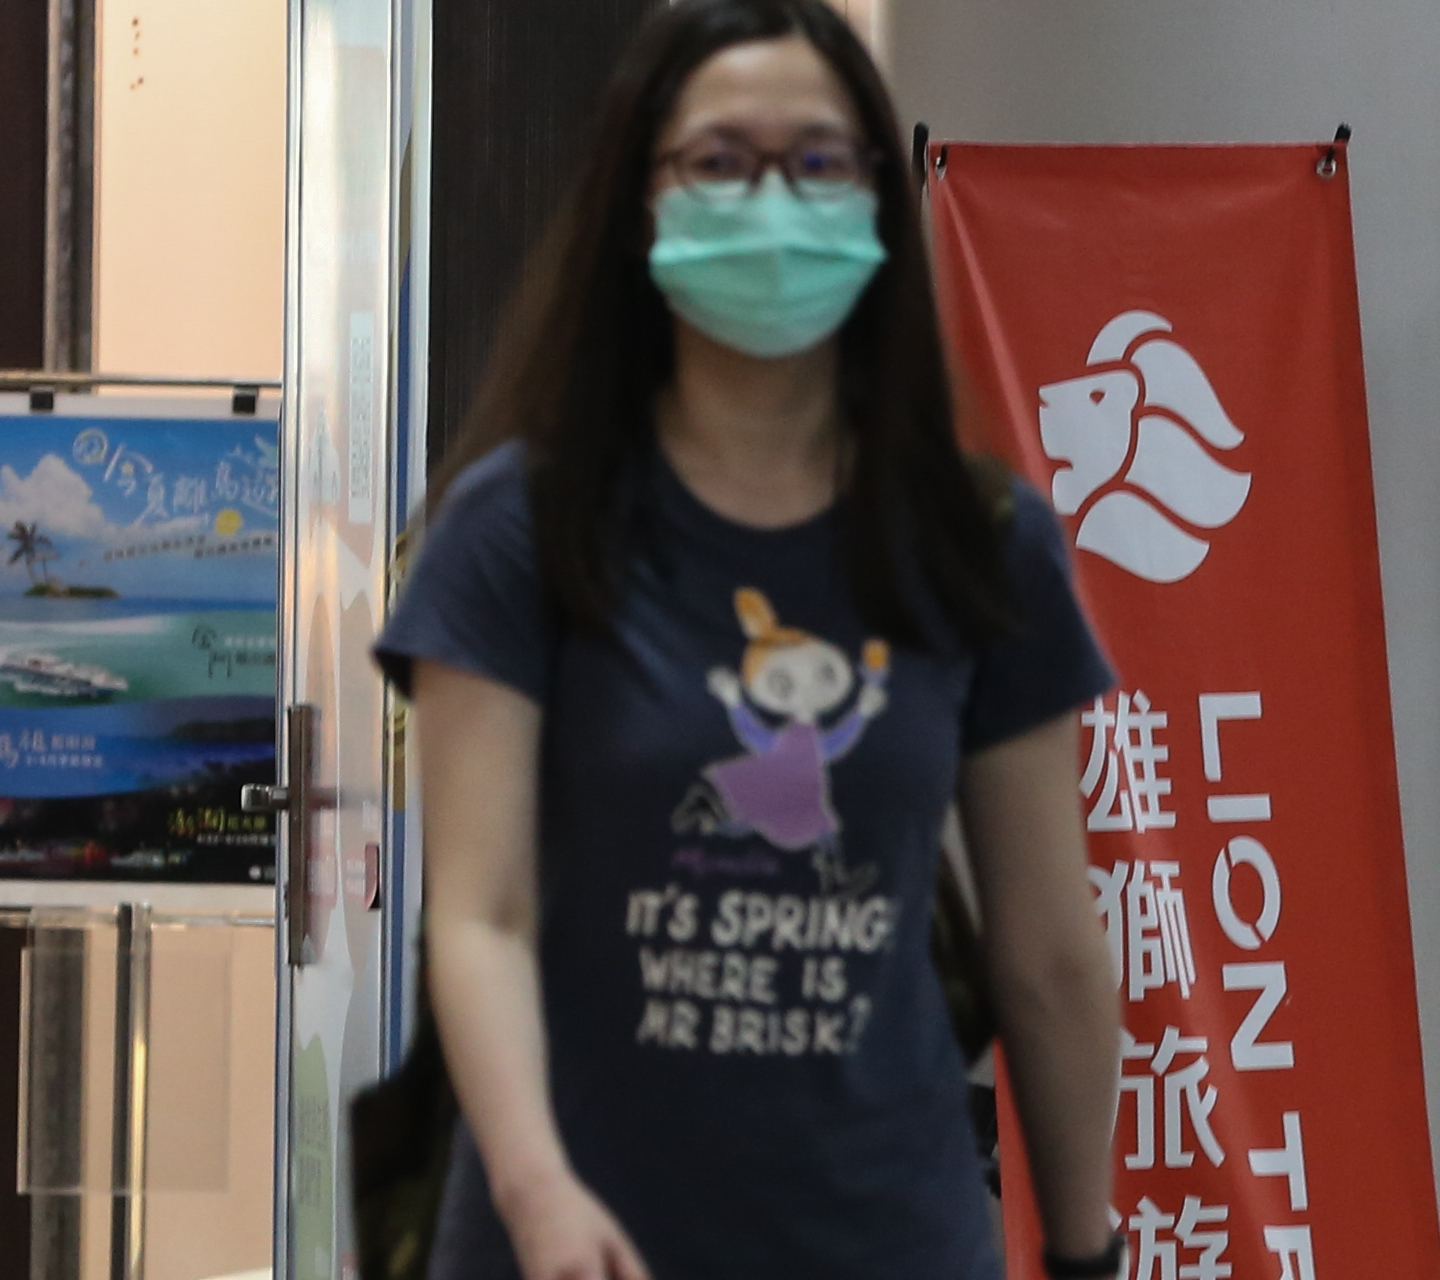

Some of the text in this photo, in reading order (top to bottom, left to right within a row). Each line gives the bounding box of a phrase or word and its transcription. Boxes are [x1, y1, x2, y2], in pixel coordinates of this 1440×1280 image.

[1198, 692, 1295, 1072] LION
[625, 887, 700, 942] IT'S
[639, 946, 848, 1005] WHERE IS
